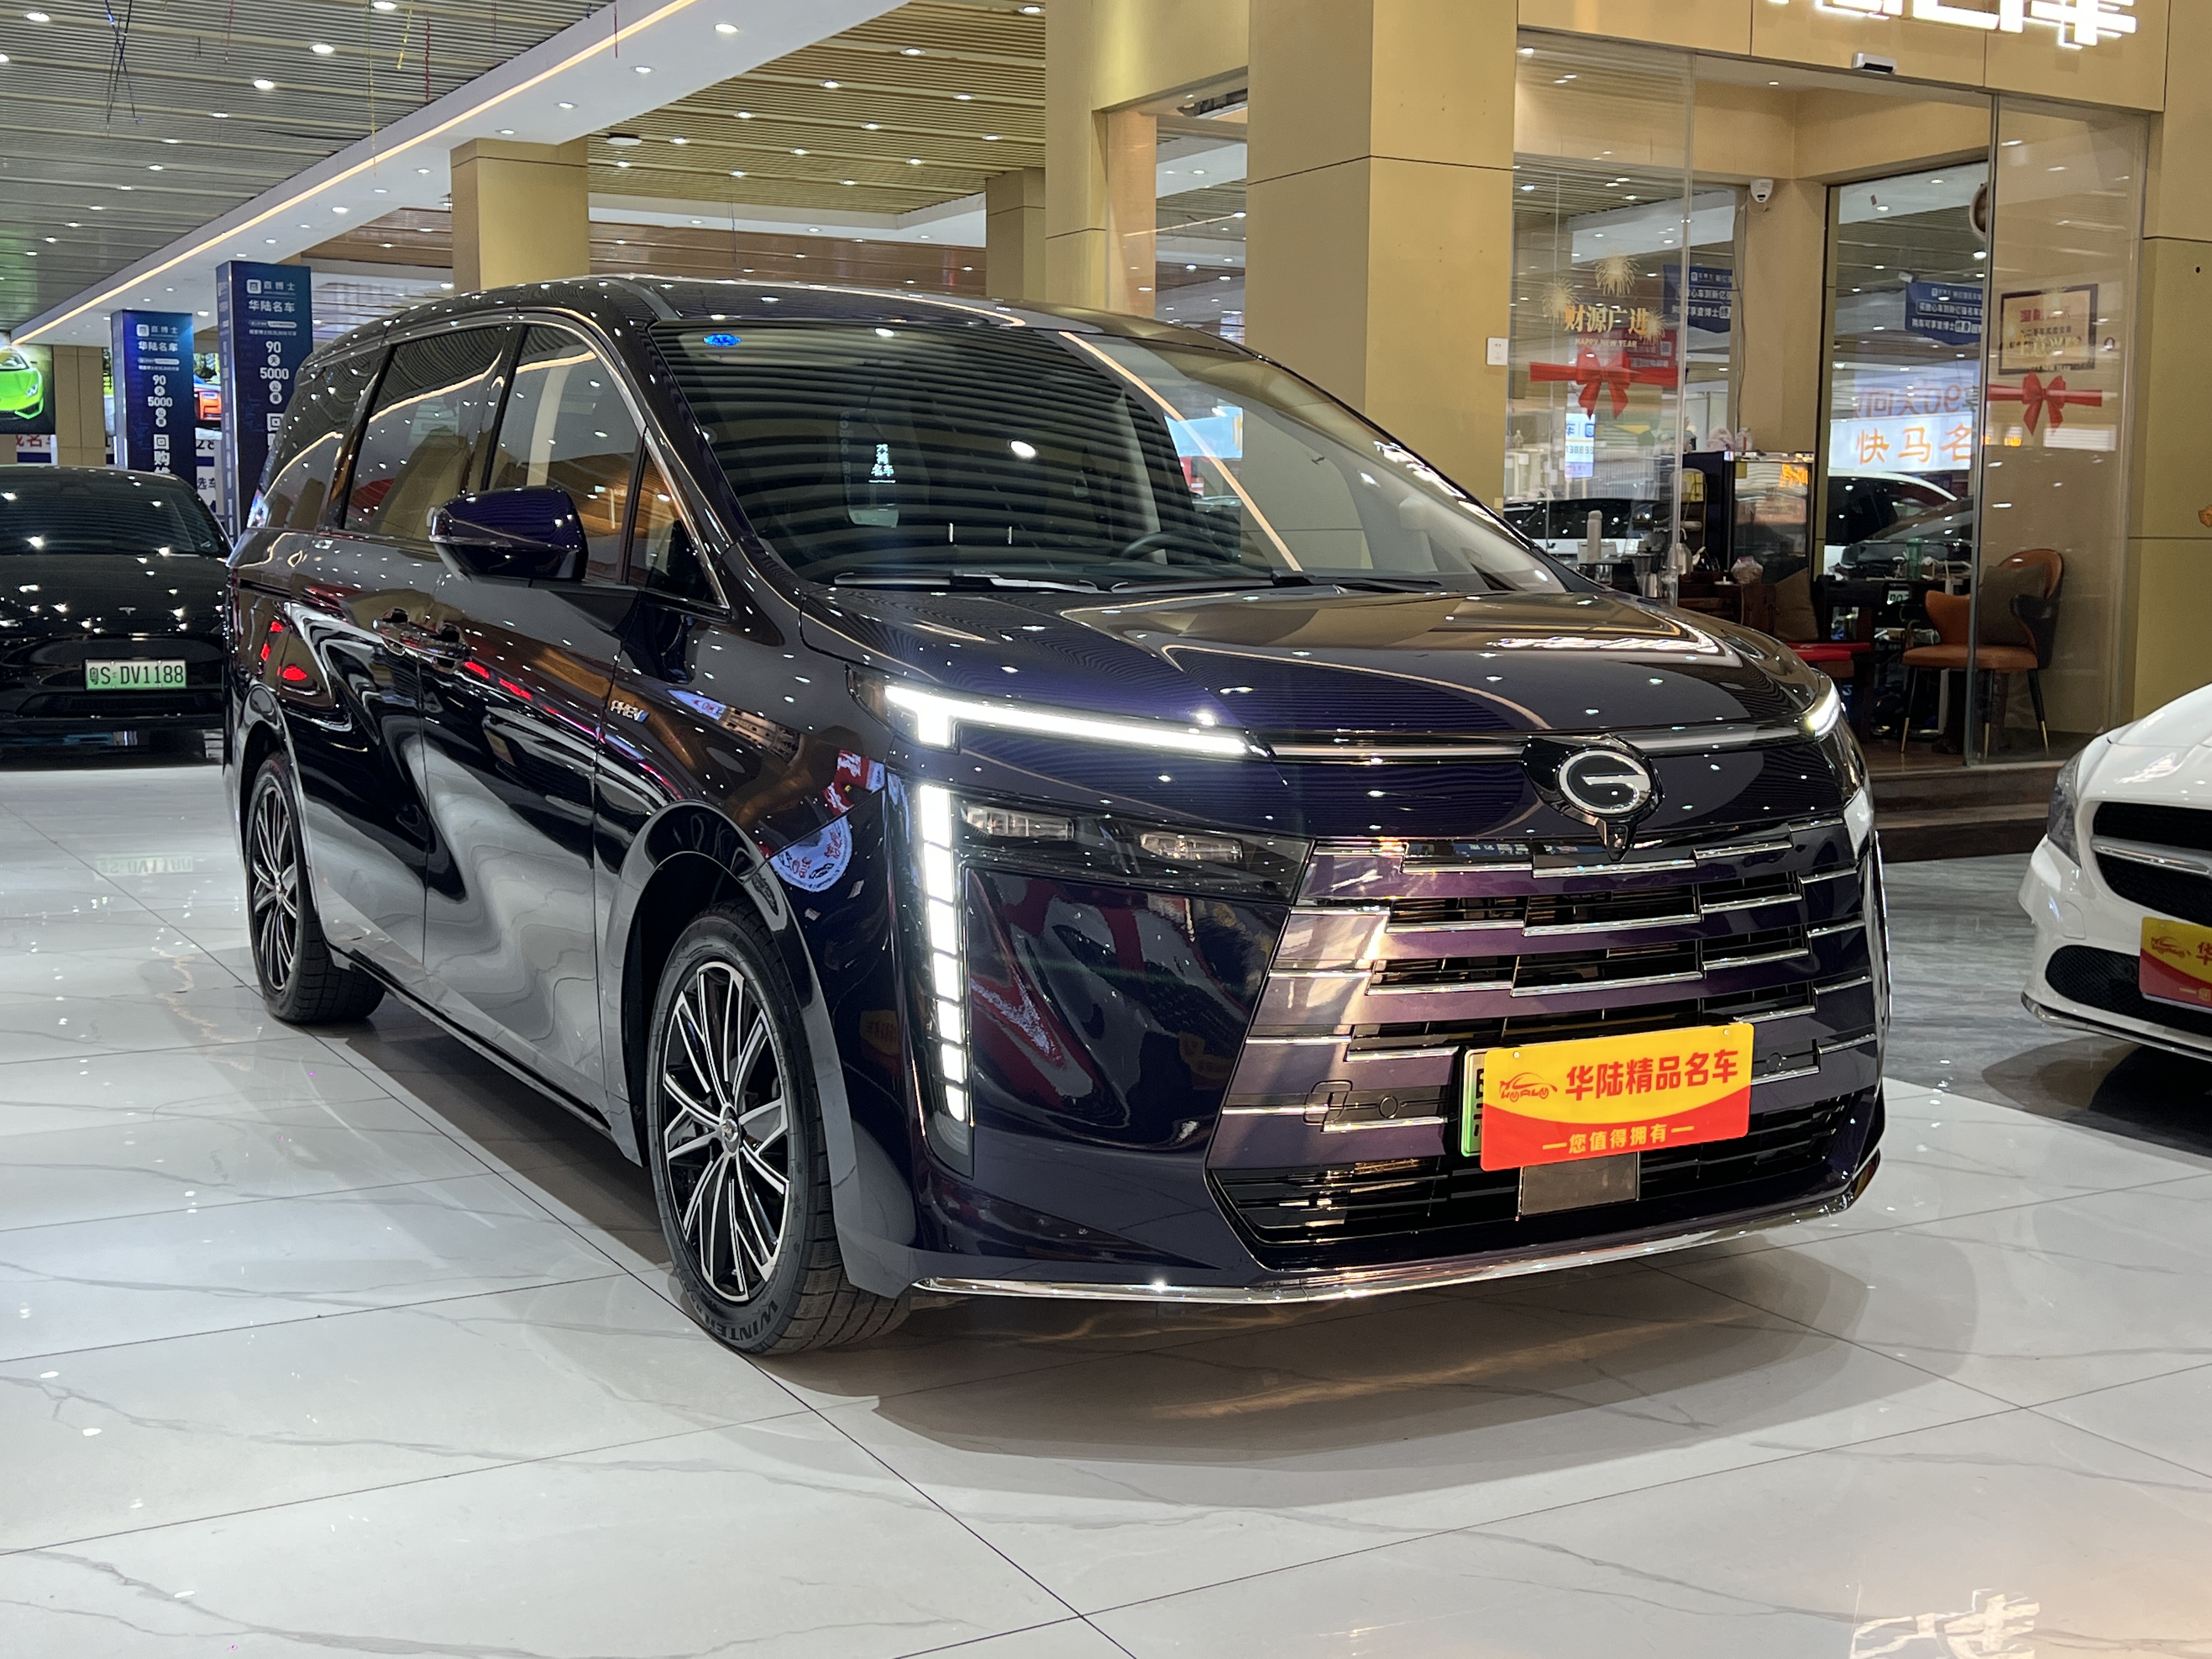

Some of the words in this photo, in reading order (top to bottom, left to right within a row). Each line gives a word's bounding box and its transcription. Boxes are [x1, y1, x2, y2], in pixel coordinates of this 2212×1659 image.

[249, 300, 295, 313] 华陆名车
[1564, 304, 1650, 335] 财源广进
[138, 341, 178, 352] 华陆名车
[266, 341, 281, 353] 90
[1575, 337, 1598, 346] HAPPY
[1600, 338, 1616, 347] NEW
[1618, 340, 1637, 348] YEAR
[152, 374, 167, 385] 90
[259, 367, 289, 380] 5000
[148, 396, 173, 407] 5000
[120, 665, 183, 685] DV1188
[1565, 1048, 1739, 1102] 华陆精品名车
